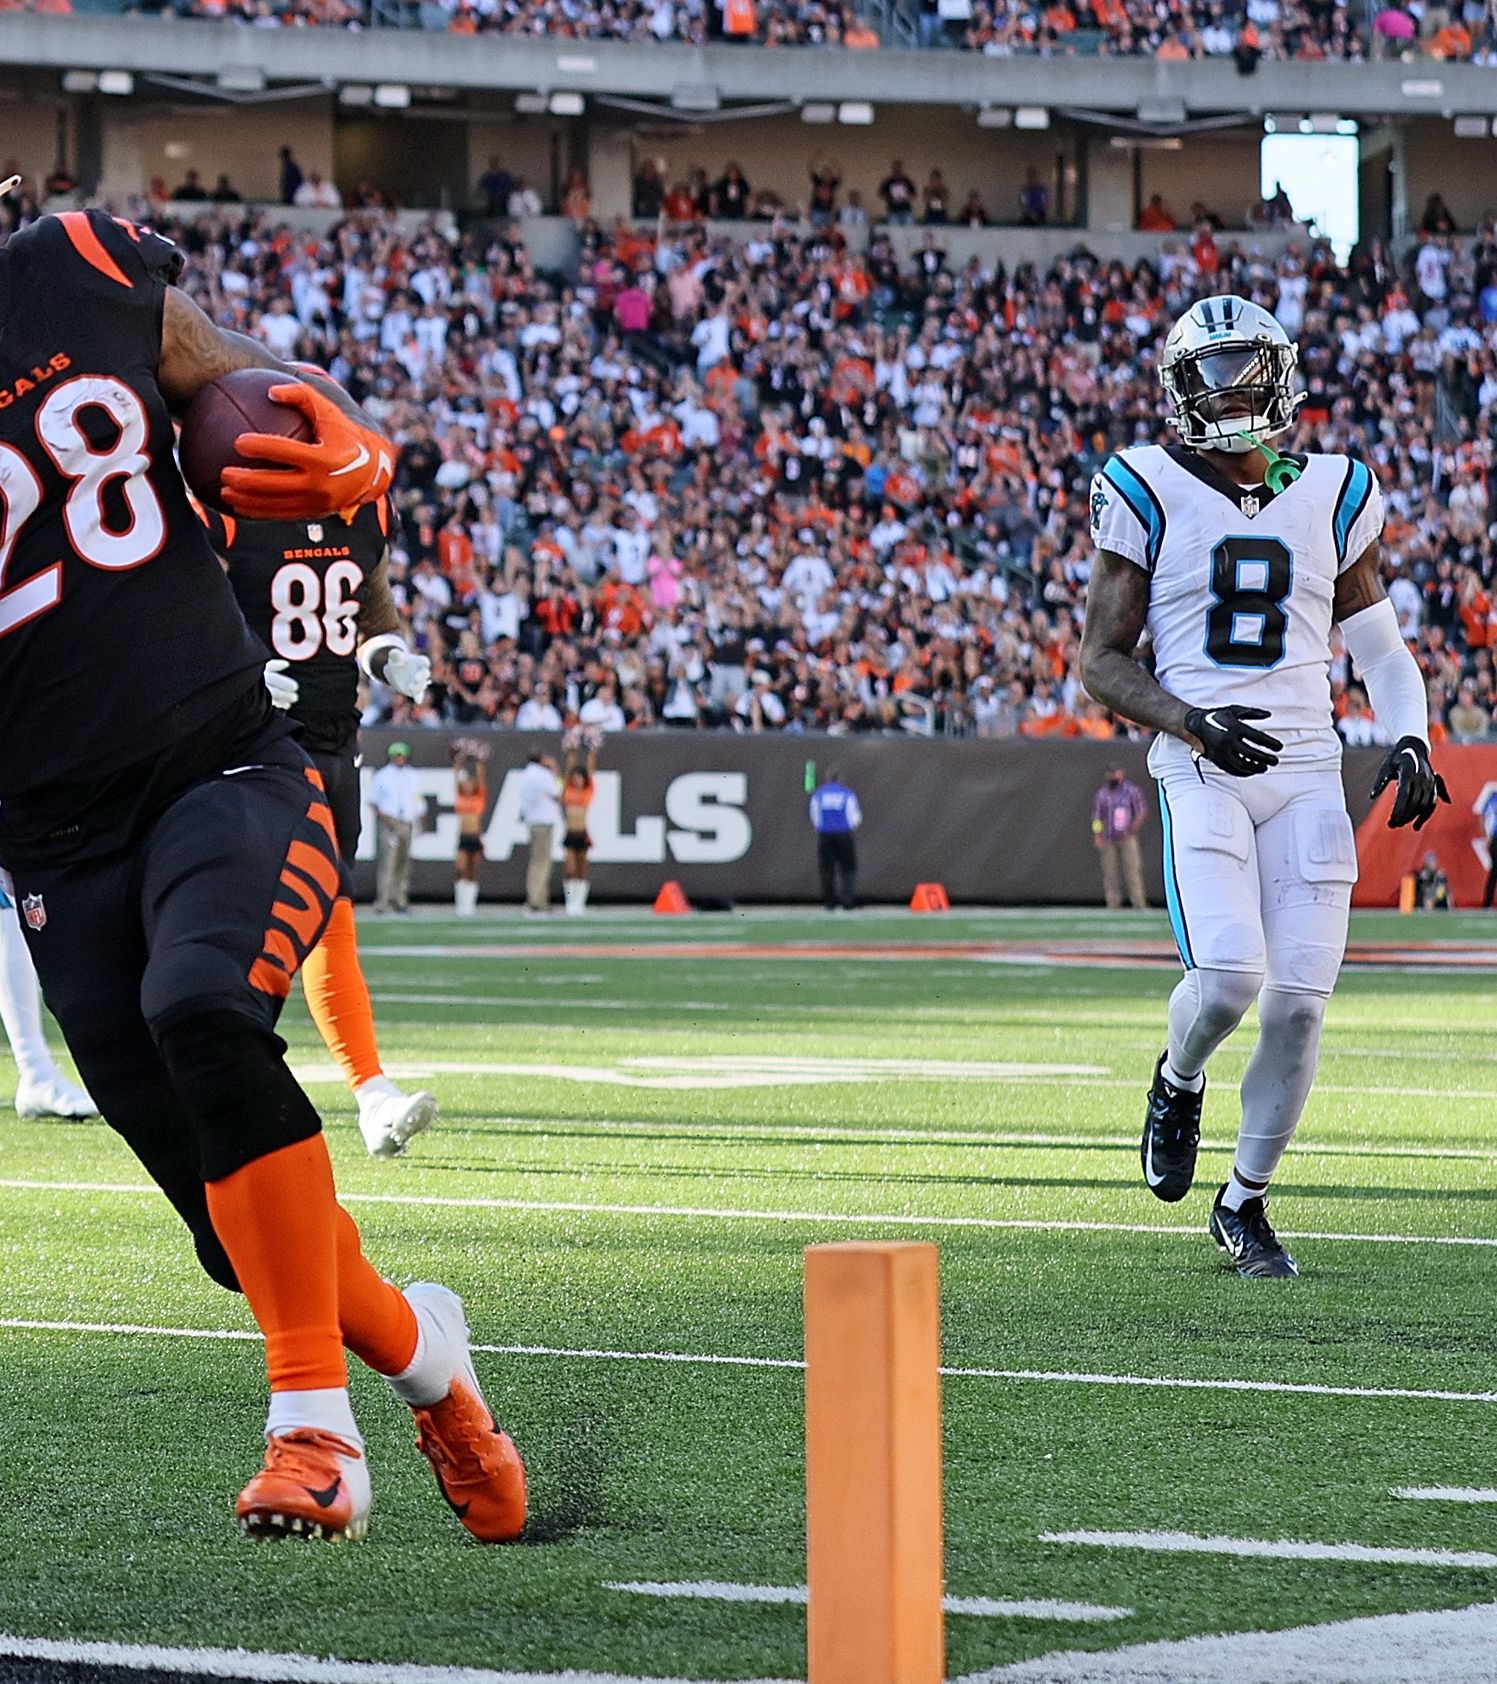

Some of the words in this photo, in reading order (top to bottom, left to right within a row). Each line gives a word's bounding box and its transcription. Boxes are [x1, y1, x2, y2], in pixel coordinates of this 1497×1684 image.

[283, 546, 351, 559] BENGALS
[1203, 534, 1295, 670] 8
[271, 560, 364, 661] 86
